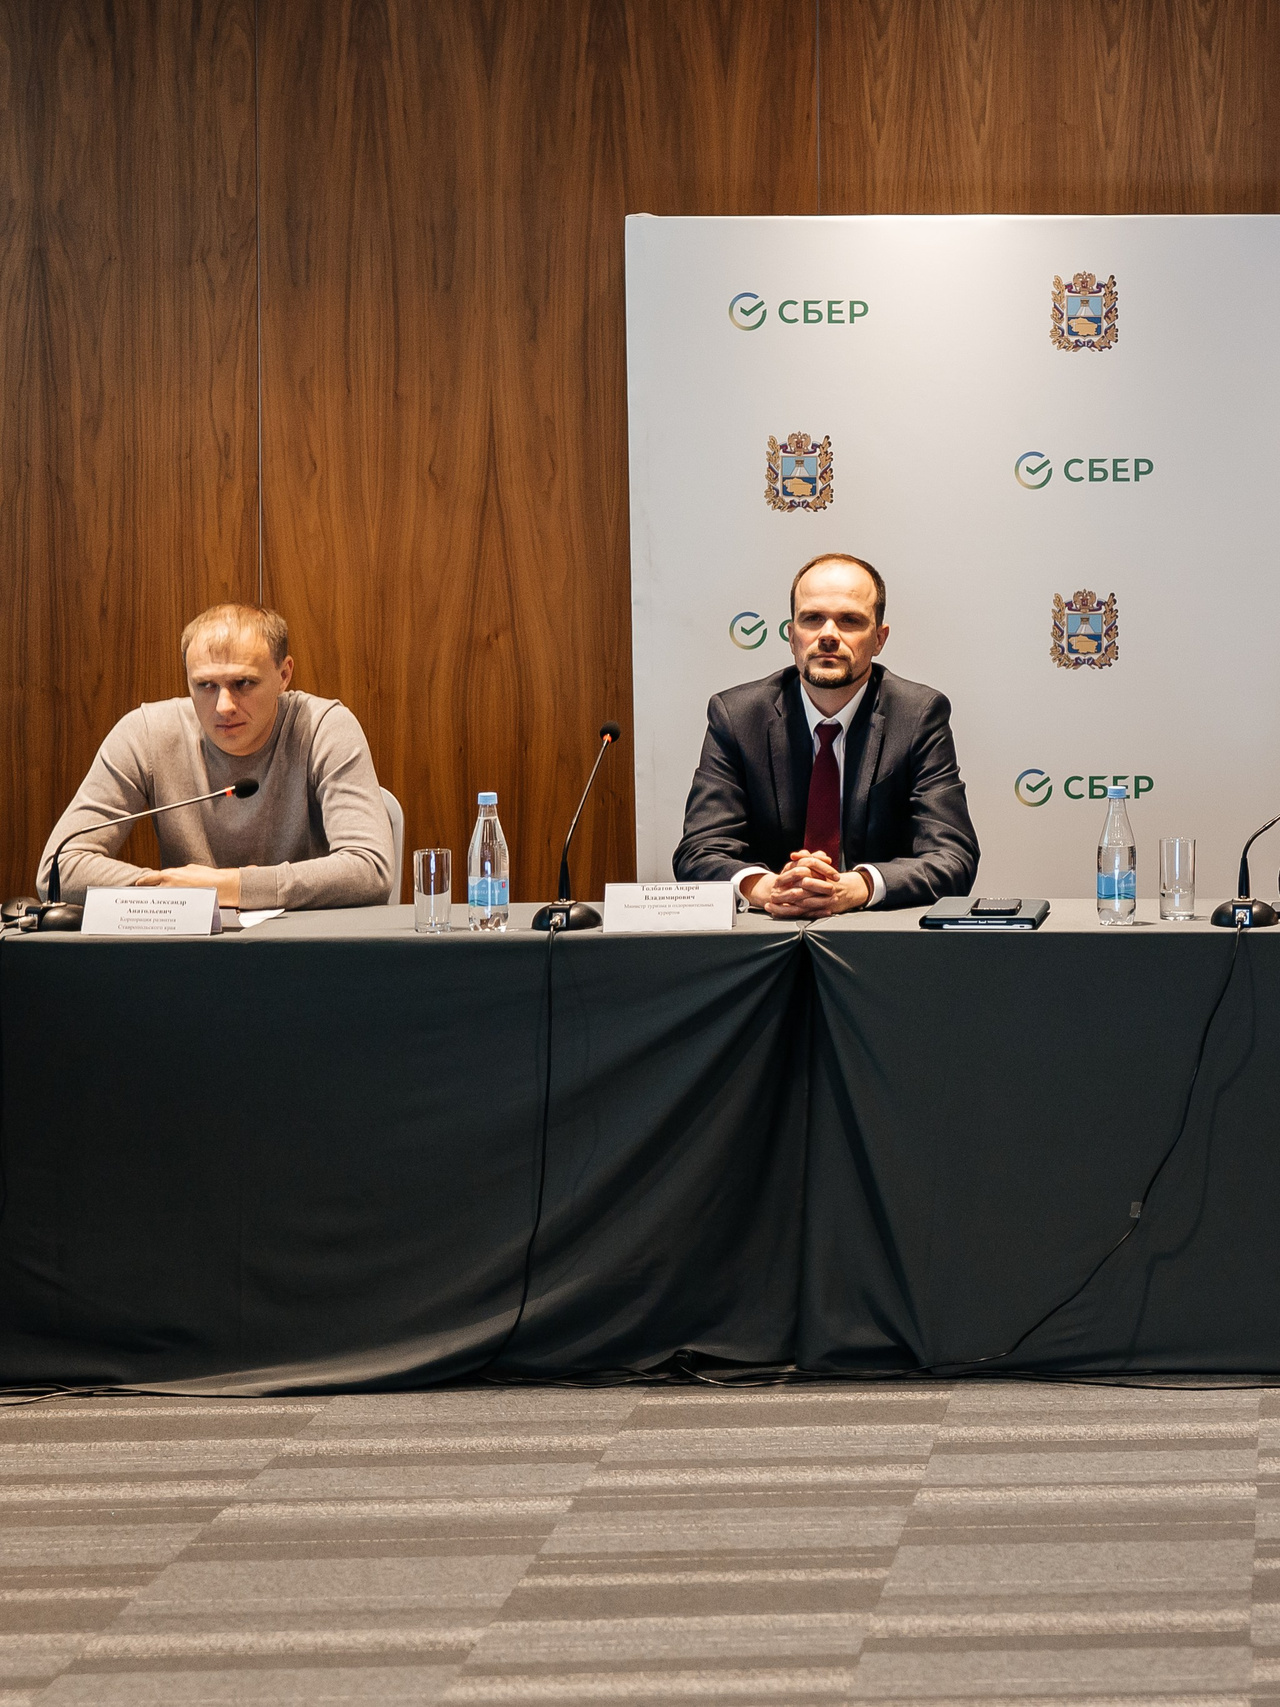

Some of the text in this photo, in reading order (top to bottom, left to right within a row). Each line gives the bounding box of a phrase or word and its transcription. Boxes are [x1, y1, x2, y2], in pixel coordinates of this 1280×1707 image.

[779, 301, 868, 324] СБЕР
[1065, 459, 1154, 482] СБЕР
[1065, 775, 1154, 799] СБЕР
[149, 898, 187, 906] Александр
[644, 894, 696, 902] Владимирович
